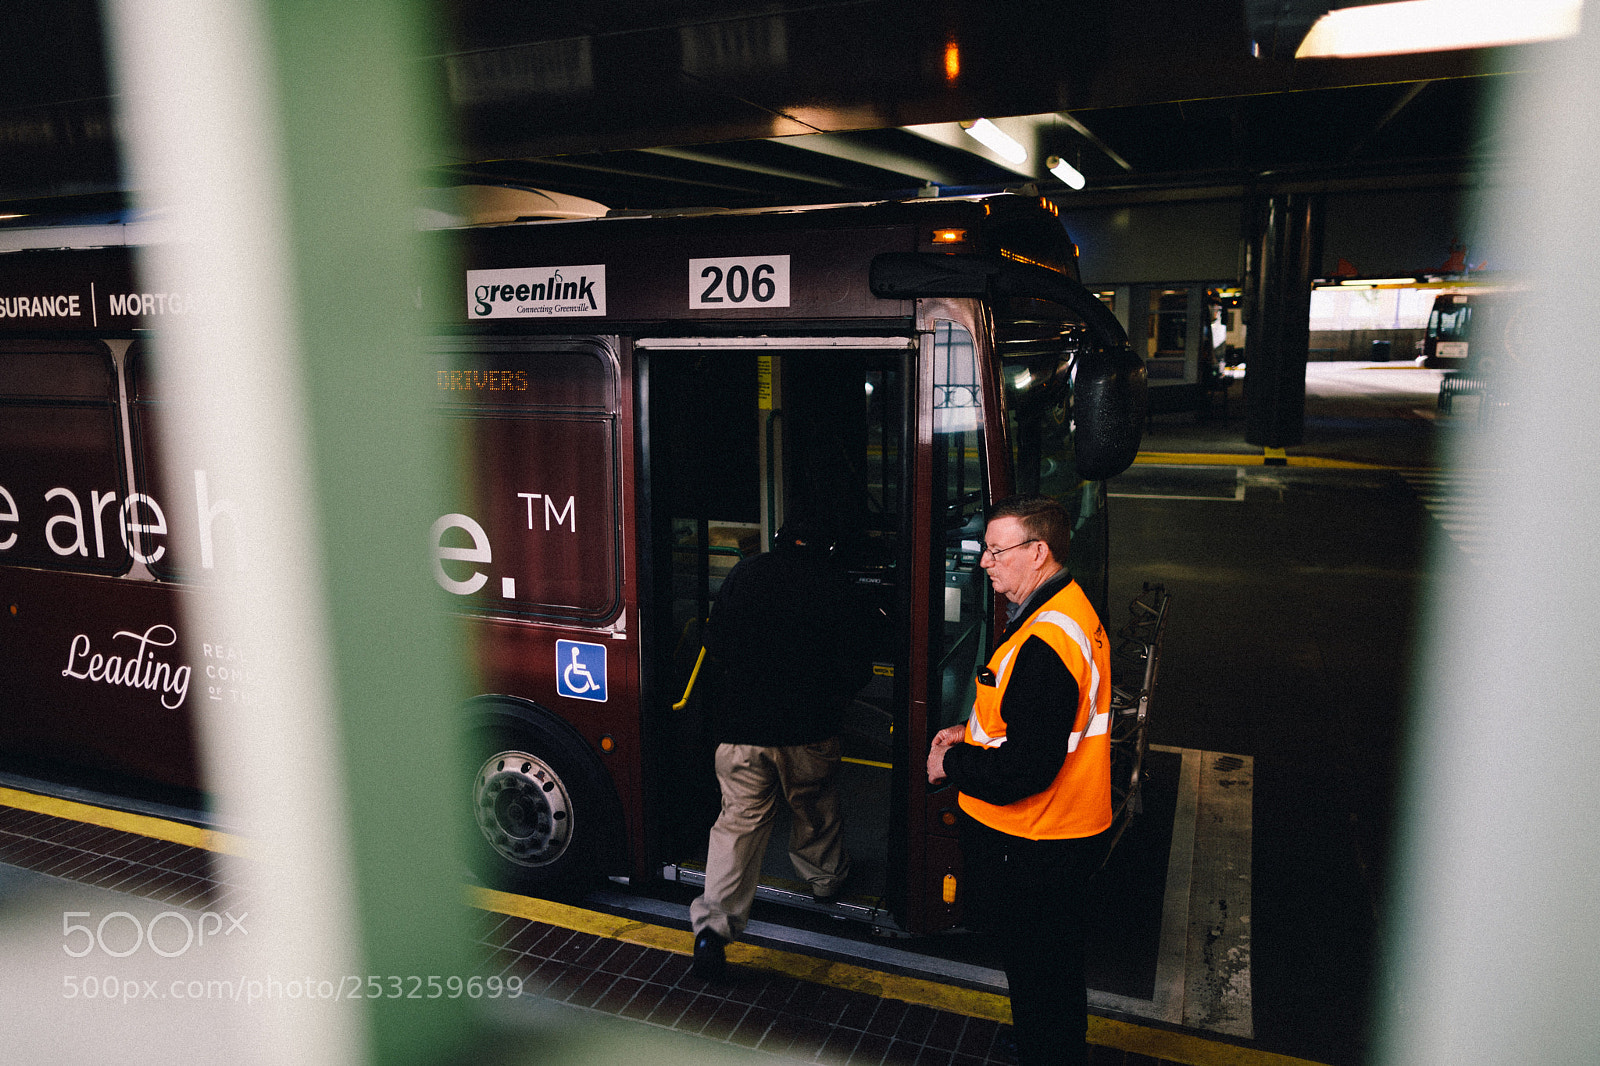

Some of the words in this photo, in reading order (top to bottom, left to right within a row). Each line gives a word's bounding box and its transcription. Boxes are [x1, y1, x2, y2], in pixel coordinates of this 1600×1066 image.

[474, 269, 598, 316] greenlink
[700, 263, 777, 304] 206
[516, 304, 553, 315] Connecting
[554, 303, 589, 313] Greenville
[436, 370, 528, 391] DRIVERS
[44, 487, 168, 564] are
[517, 492, 576, 533] TM
[62, 624, 192, 710] Leading
